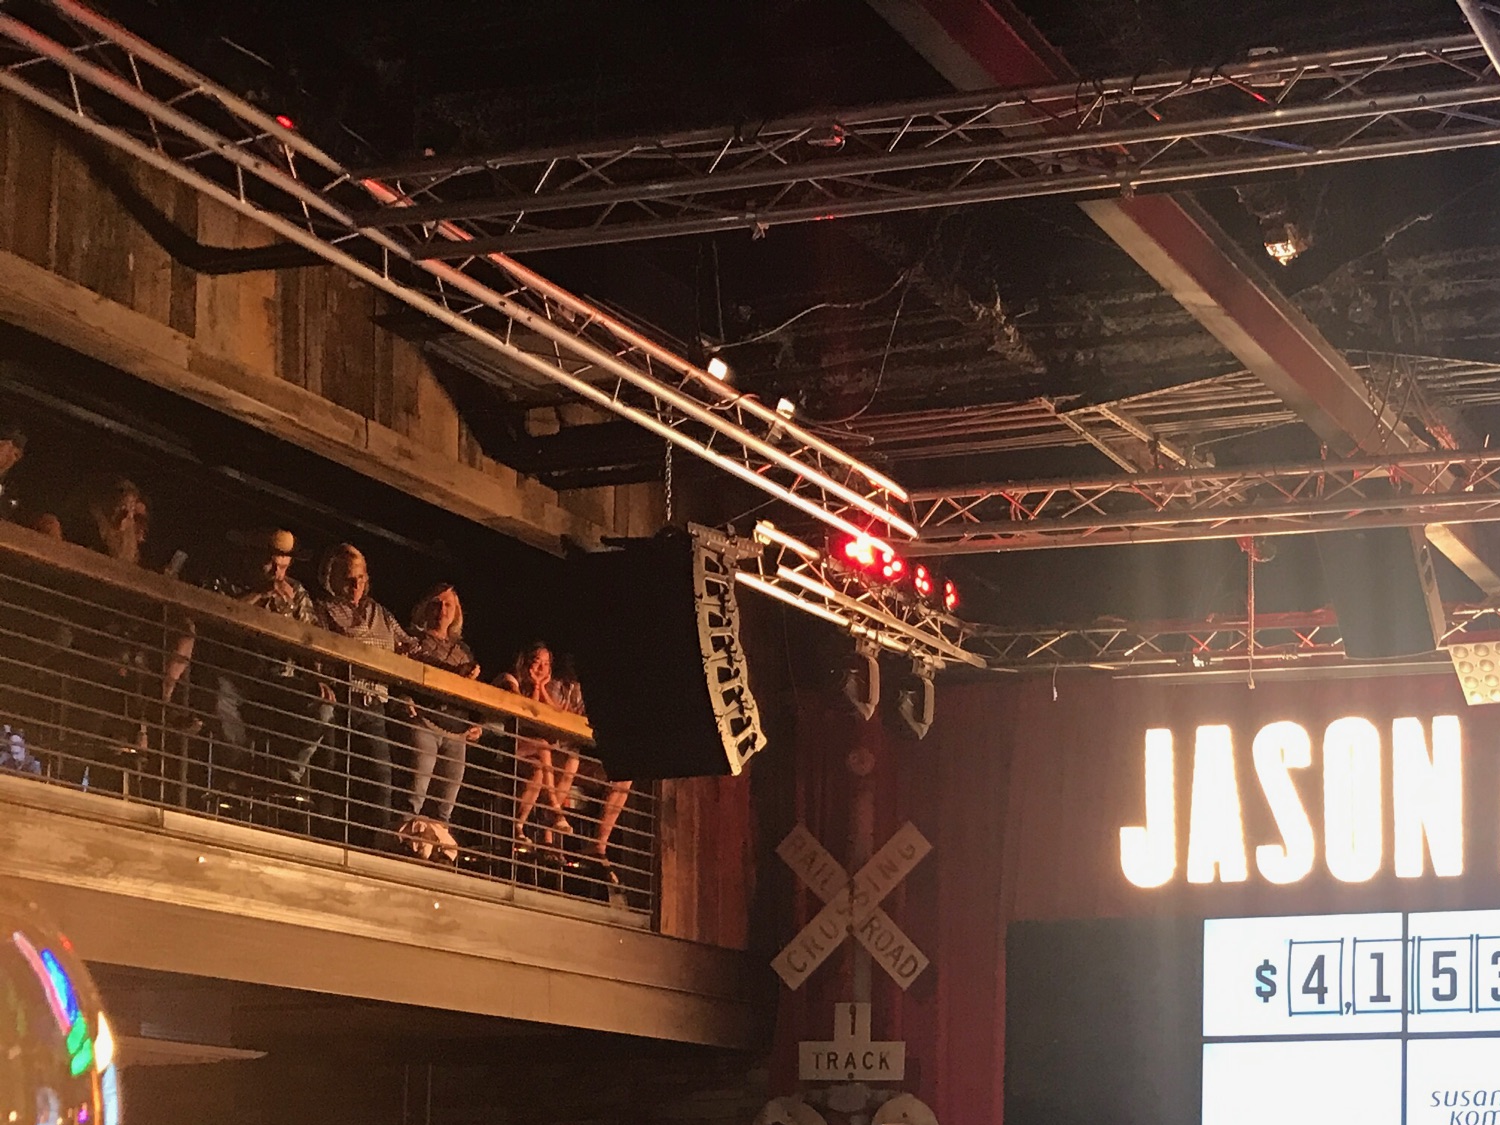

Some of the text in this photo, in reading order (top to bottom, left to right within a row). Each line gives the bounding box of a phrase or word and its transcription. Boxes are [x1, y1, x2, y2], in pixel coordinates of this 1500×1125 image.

[1119, 714, 1465, 889] JASON
[860, 914, 919, 979] ROAD
[811, 1050, 890, 1070] TRACK
